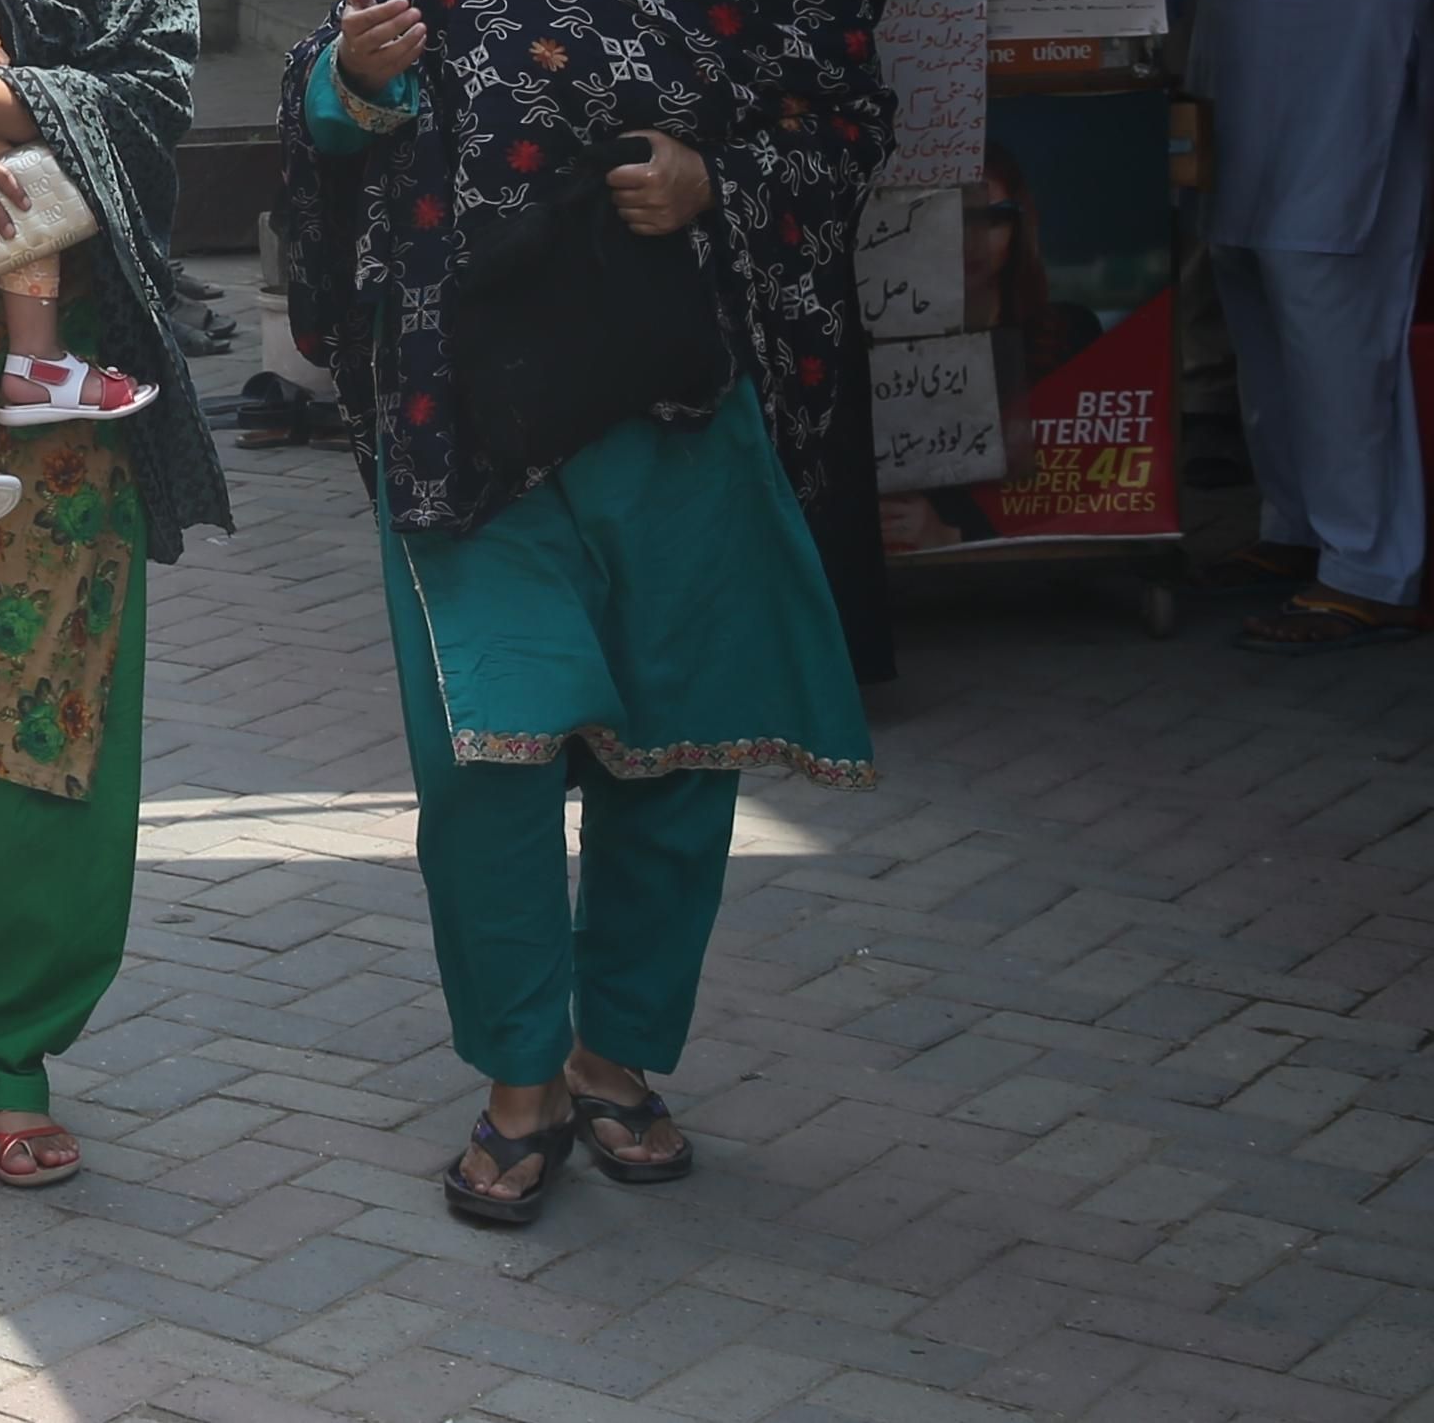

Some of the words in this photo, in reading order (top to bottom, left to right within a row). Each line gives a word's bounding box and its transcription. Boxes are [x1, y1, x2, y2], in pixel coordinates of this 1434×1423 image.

[1033, 41, 1092, 62] ufone
[865, 278, 931, 321] حاصل
[921, 363, 967, 398] ایزی
[1076, 390, 1154, 418] BEST
[1032, 417, 1154, 445] TERNET
[1035, 449, 1081, 470] AZZ
[1086, 446, 1155, 489] 4G
[1001, 494, 1052, 516] WiFi
[1056, 492, 1155, 514] DEVICES
